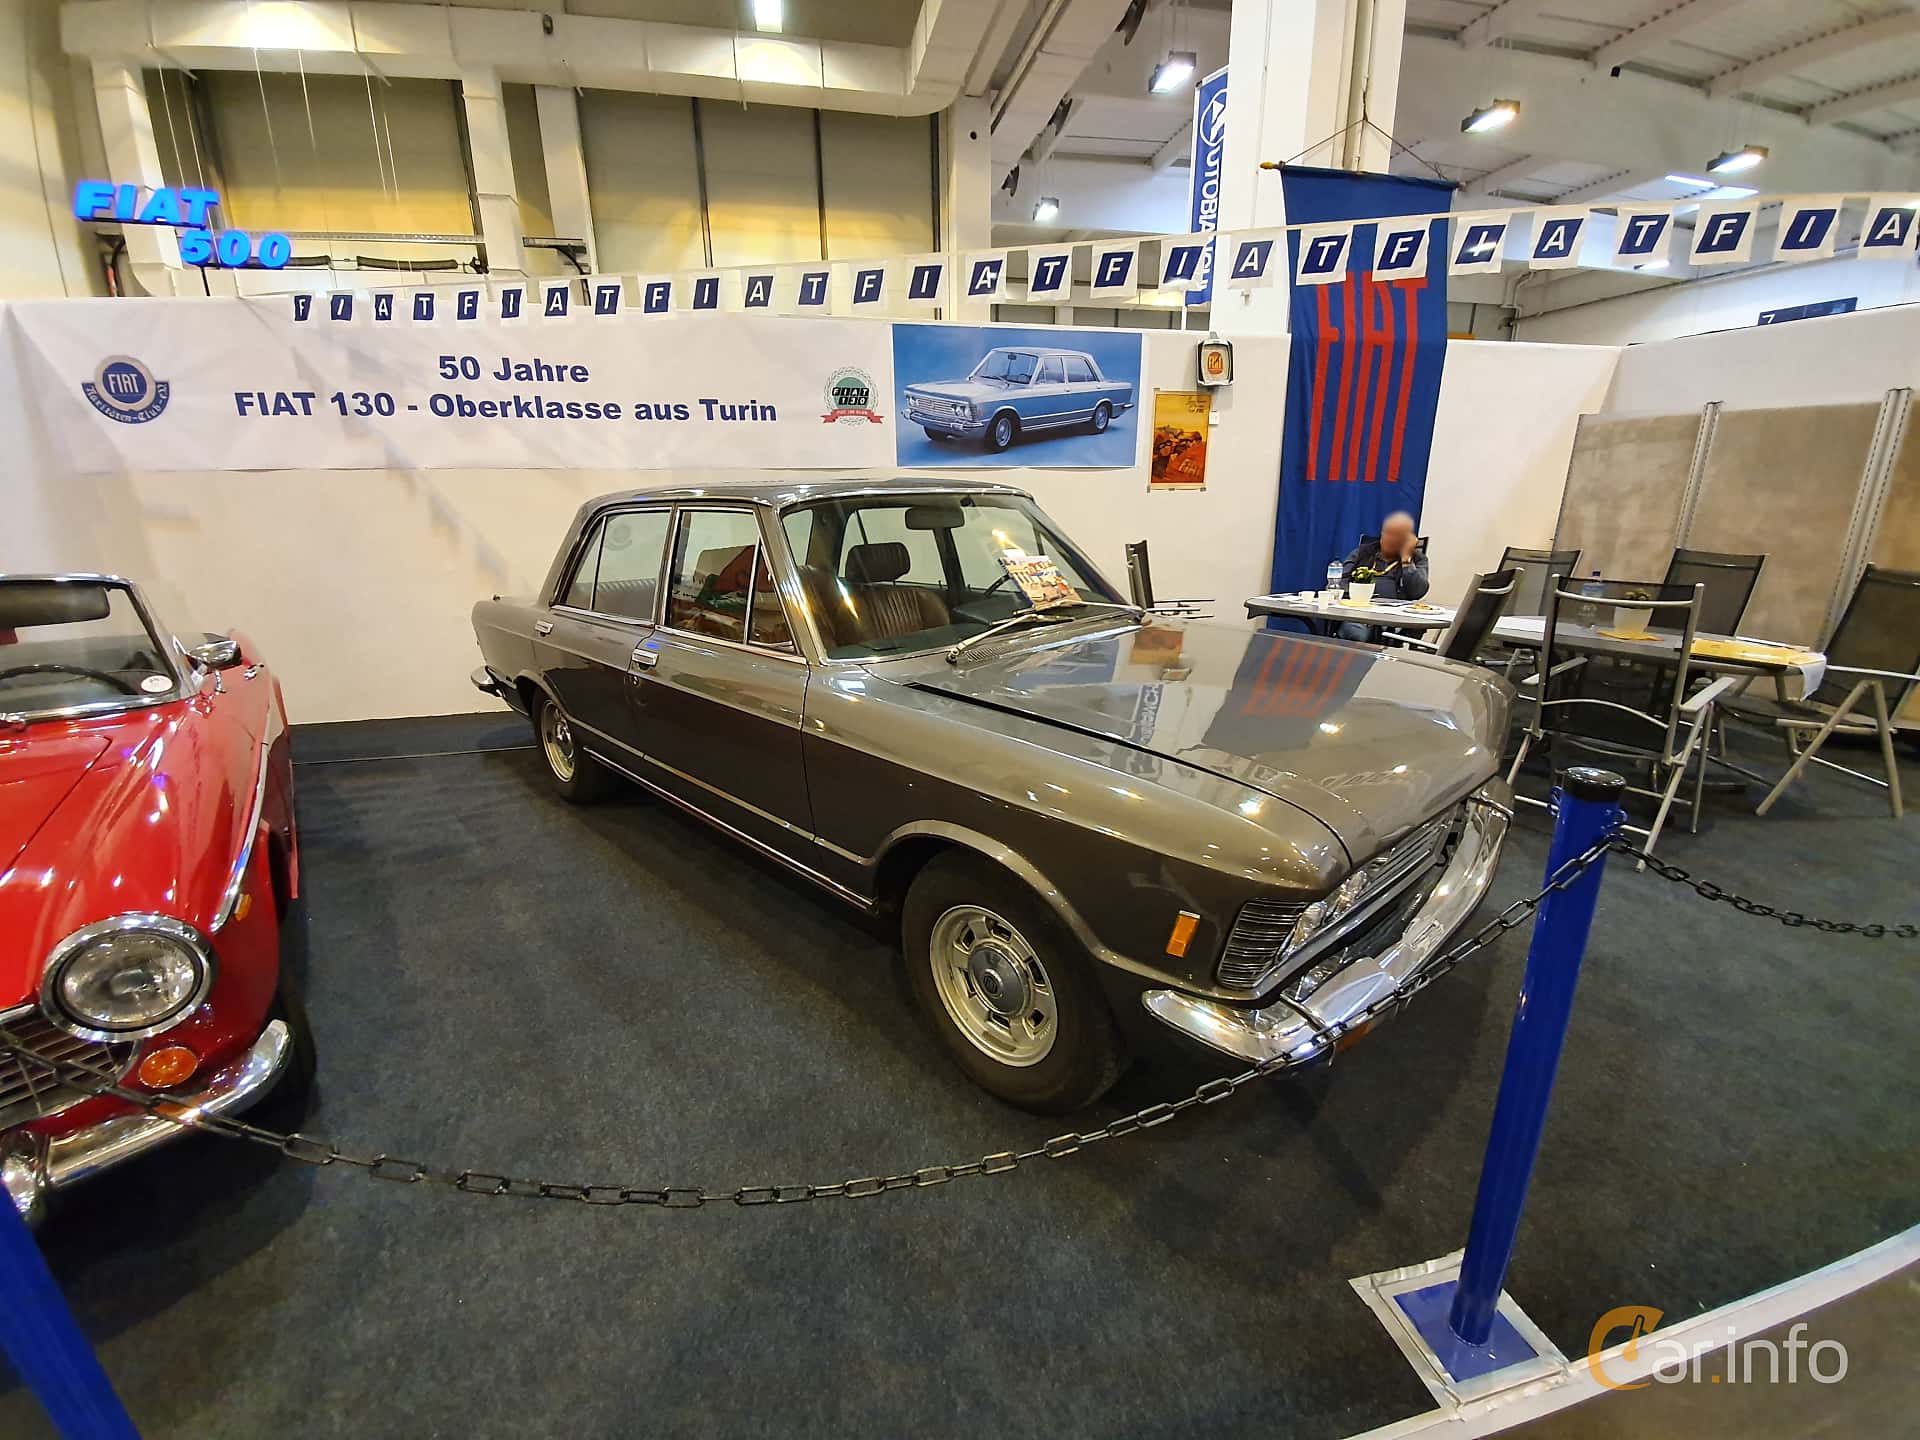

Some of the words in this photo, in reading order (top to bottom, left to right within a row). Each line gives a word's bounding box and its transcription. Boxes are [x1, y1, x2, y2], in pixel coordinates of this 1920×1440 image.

[75, 181, 220, 228] FIAT
[181, 229, 292, 268] 500
[108, 373, 140, 394] FIAT
[438, 355, 481, 381] 50
[493, 356, 590, 383] Jahre
[1306, 271, 1429, 481] FIAT
[234, 391, 317, 417] FIAT
[329, 392, 396, 417] 130
[406, 403, 419, 412] -
[428, 393, 622, 421] Oberklasse
[633, 399, 691, 422] aus
[698, 397, 777, 422] Turin
[833, 388, 868, 396] FIAT
[840, 397, 866, 405] 130
